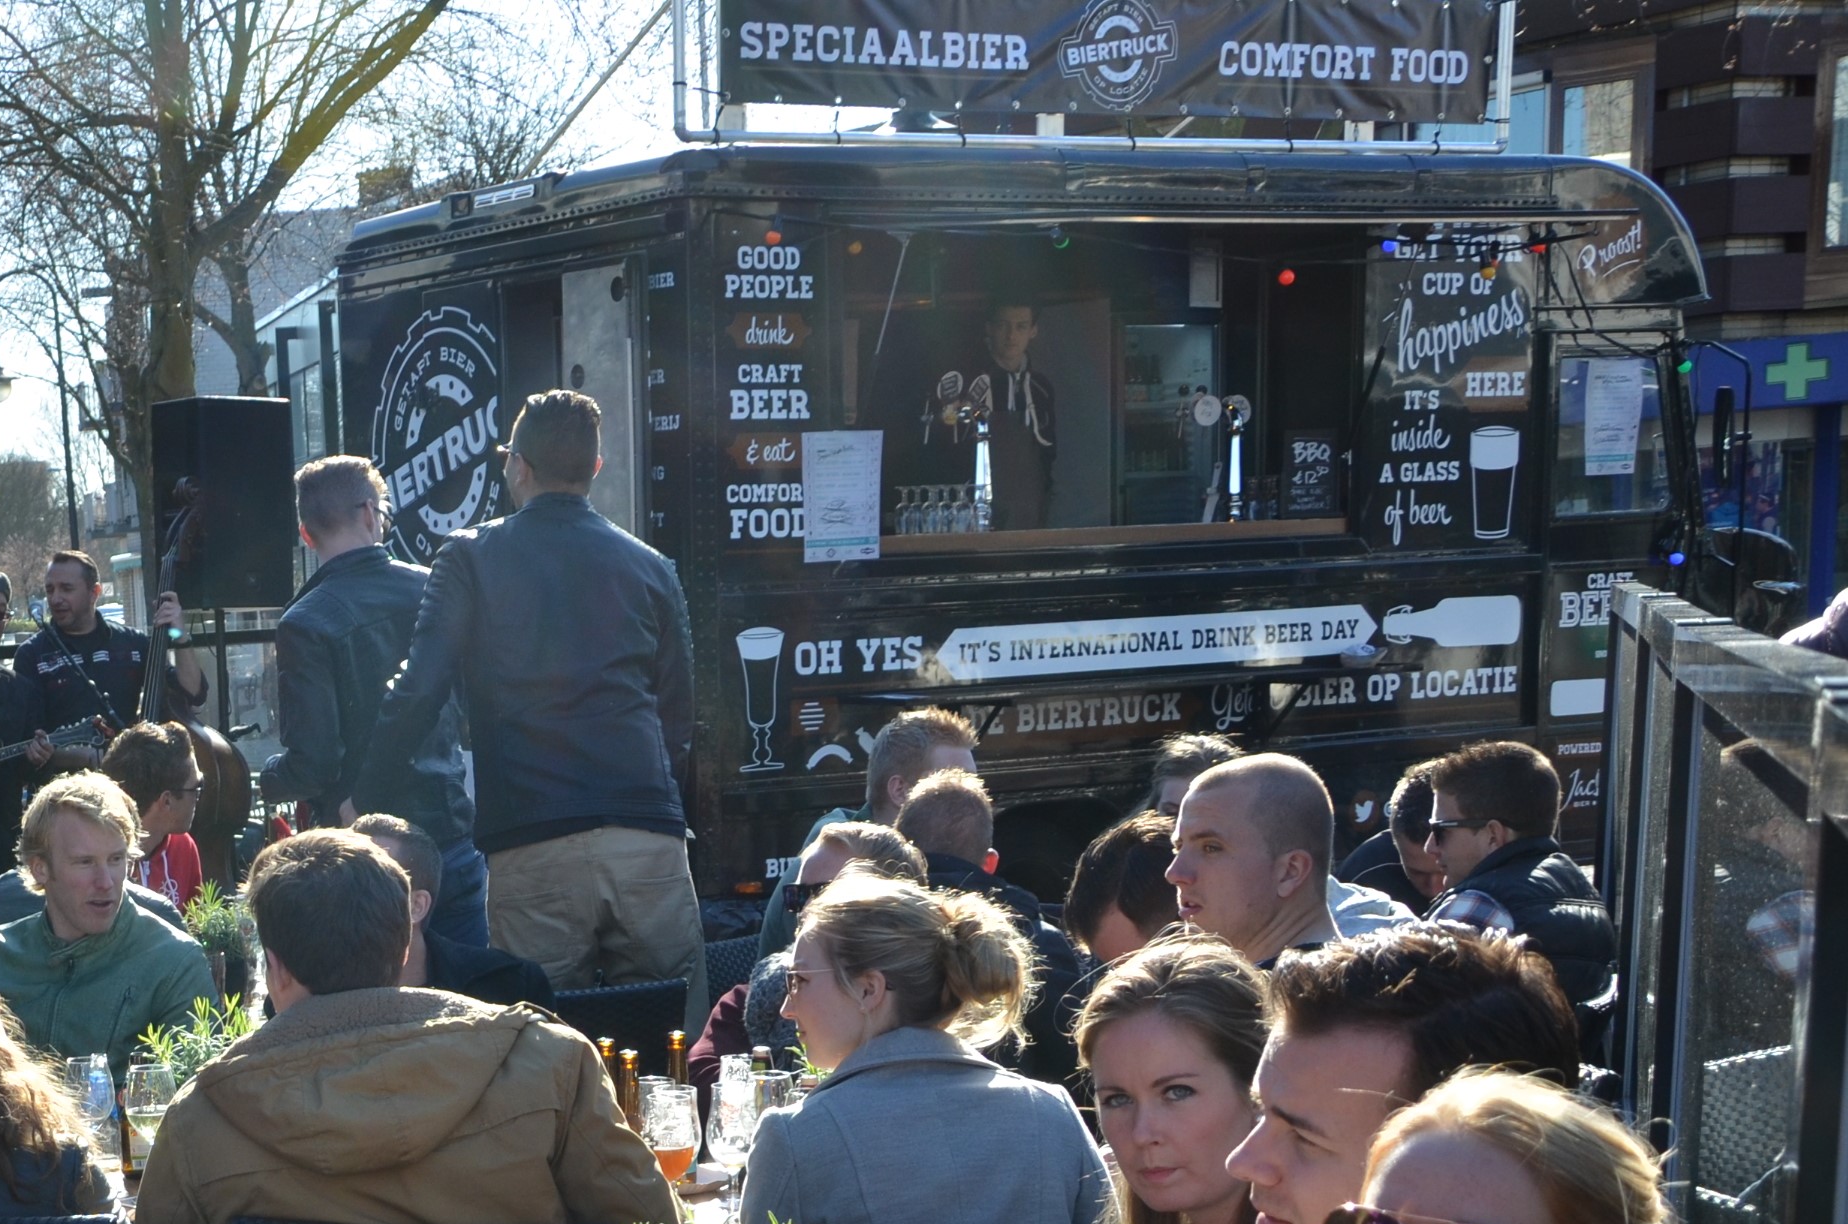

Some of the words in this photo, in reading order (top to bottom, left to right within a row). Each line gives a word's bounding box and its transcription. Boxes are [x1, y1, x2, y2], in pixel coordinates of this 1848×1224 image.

[1123, 4, 1143, 24] BIER
[740, 21, 1029, 70] SPECIAALBIER
[1067, 33, 1169, 66] BIERTRUCK
[1219, 41, 1375, 81] COMFORT
[1390, 47, 1468, 84] FOOD
[1093, 75, 1106, 88] OP
[1109, 68, 1148, 95] LOCATIE
[737, 246, 800, 270] GOOD
[1577, 219, 1642, 277] Proost!
[725, 275, 813, 299] PEOPLE
[1422, 272, 1464, 295] CUP
[745, 315, 794, 345] drink
[1398, 288, 1524, 374] happiness
[738, 364, 802, 383] CRAFT
[1465, 371, 1525, 397] HERE
[394, 350, 432, 432] GETAPT
[440, 347, 476, 378] BIER
[730, 389, 810, 420] BEER
[1404, 390, 1440, 410] IT'S
[1391, 414, 1450, 452] inside
[746, 438, 759, 464] &
[763, 438, 795, 462] eat
[1292, 442, 1331, 463] BBQ
[1379, 463, 1394, 483] A
[1400, 461, 1460, 482] GLASS
[726, 483, 803, 503] COMFOR
[1384, 489, 1404, 546] of
[1409, 488, 1452, 525] beer
[1559, 590, 1610, 627] BEE
[795, 640, 843, 676] OH
[856, 635, 922, 672] YES
[959, 639, 1001, 664] IT'S
[1010, 630, 1183, 661] INTERNATIONAL
[1192, 625, 1255, 649] DRINK
[1264, 623, 1312, 645] BEER
[1321, 618, 1359, 640] DAY
[1016, 692, 1181, 734] BIERTRUCK
[1367, 672, 1400, 702] OP
[1410, 665, 1518, 700] LOCATIE
[1558, 742, 1602, 755] POWERED
